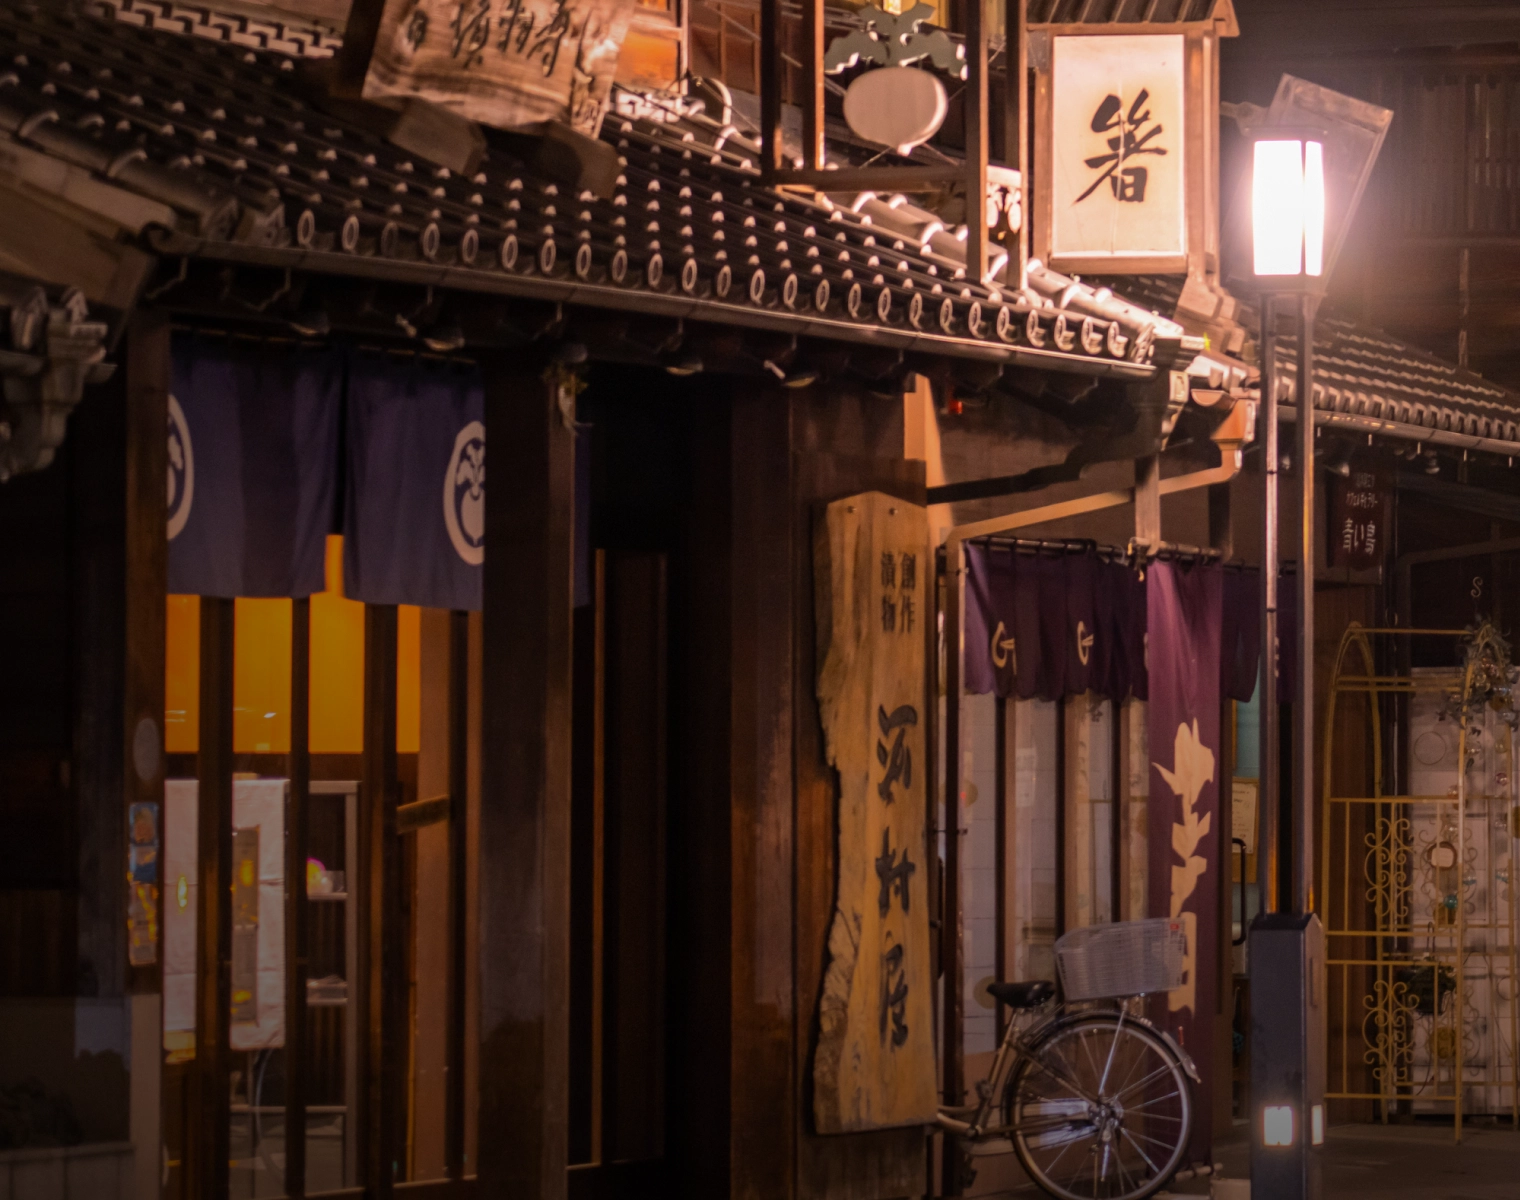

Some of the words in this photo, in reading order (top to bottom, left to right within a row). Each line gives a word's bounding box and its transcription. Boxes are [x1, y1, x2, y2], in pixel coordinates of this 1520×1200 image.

[1072, 87, 1168, 205] 箸
[1342, 517, 1376, 555] 青い鳥
[875, 704, 918, 1048] 河村屋
